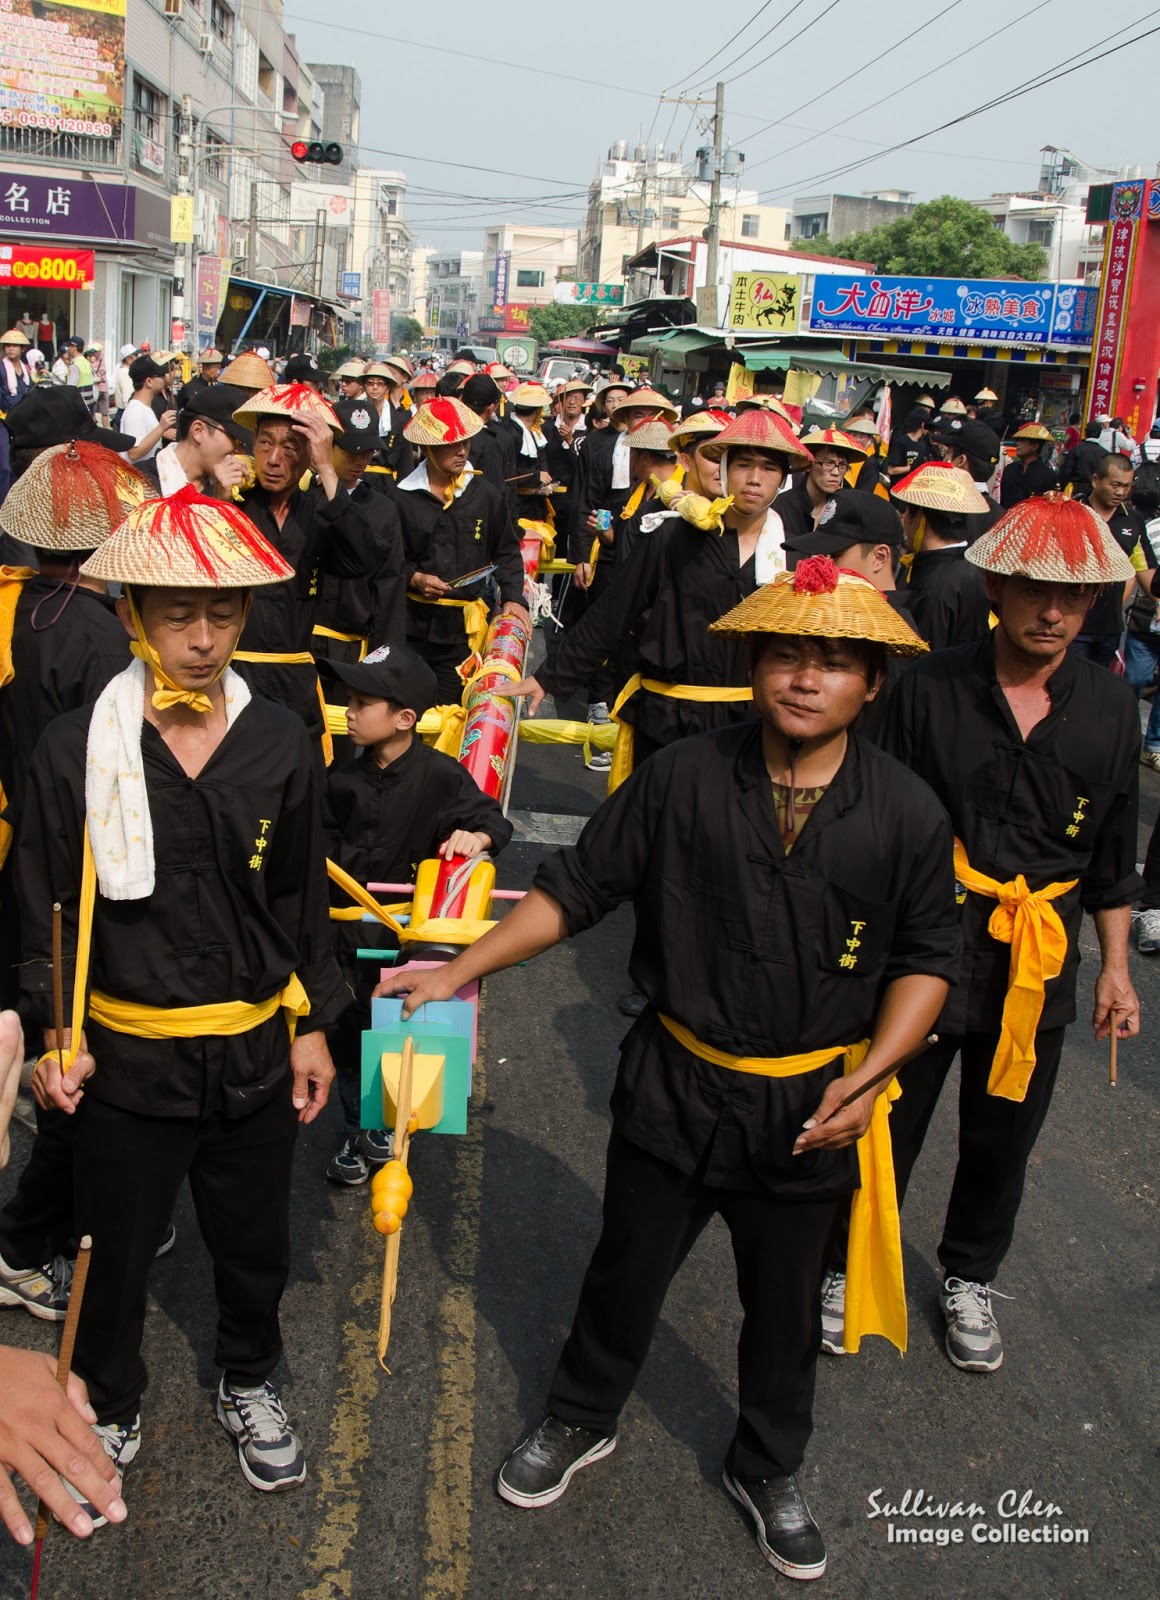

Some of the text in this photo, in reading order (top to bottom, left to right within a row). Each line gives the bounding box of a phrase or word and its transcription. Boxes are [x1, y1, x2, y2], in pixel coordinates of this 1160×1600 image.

[4, 182, 71, 216] 名店
[733, 276, 748, 325] 本土牛肉
[754, 282, 774, 304] 弘
[818, 280, 934, 319] 大西洋
[966, 295, 1040, 319] 冰熱美食
[835, 322, 865, 331] Atlantic
[867, 321, 888, 332] Chain
[928, 308, 955, 323] 冰城
[1065, 796, 1090, 838] 下中街
[248, 819, 272, 871] 下中街
[838, 920, 867, 970] 下中街
